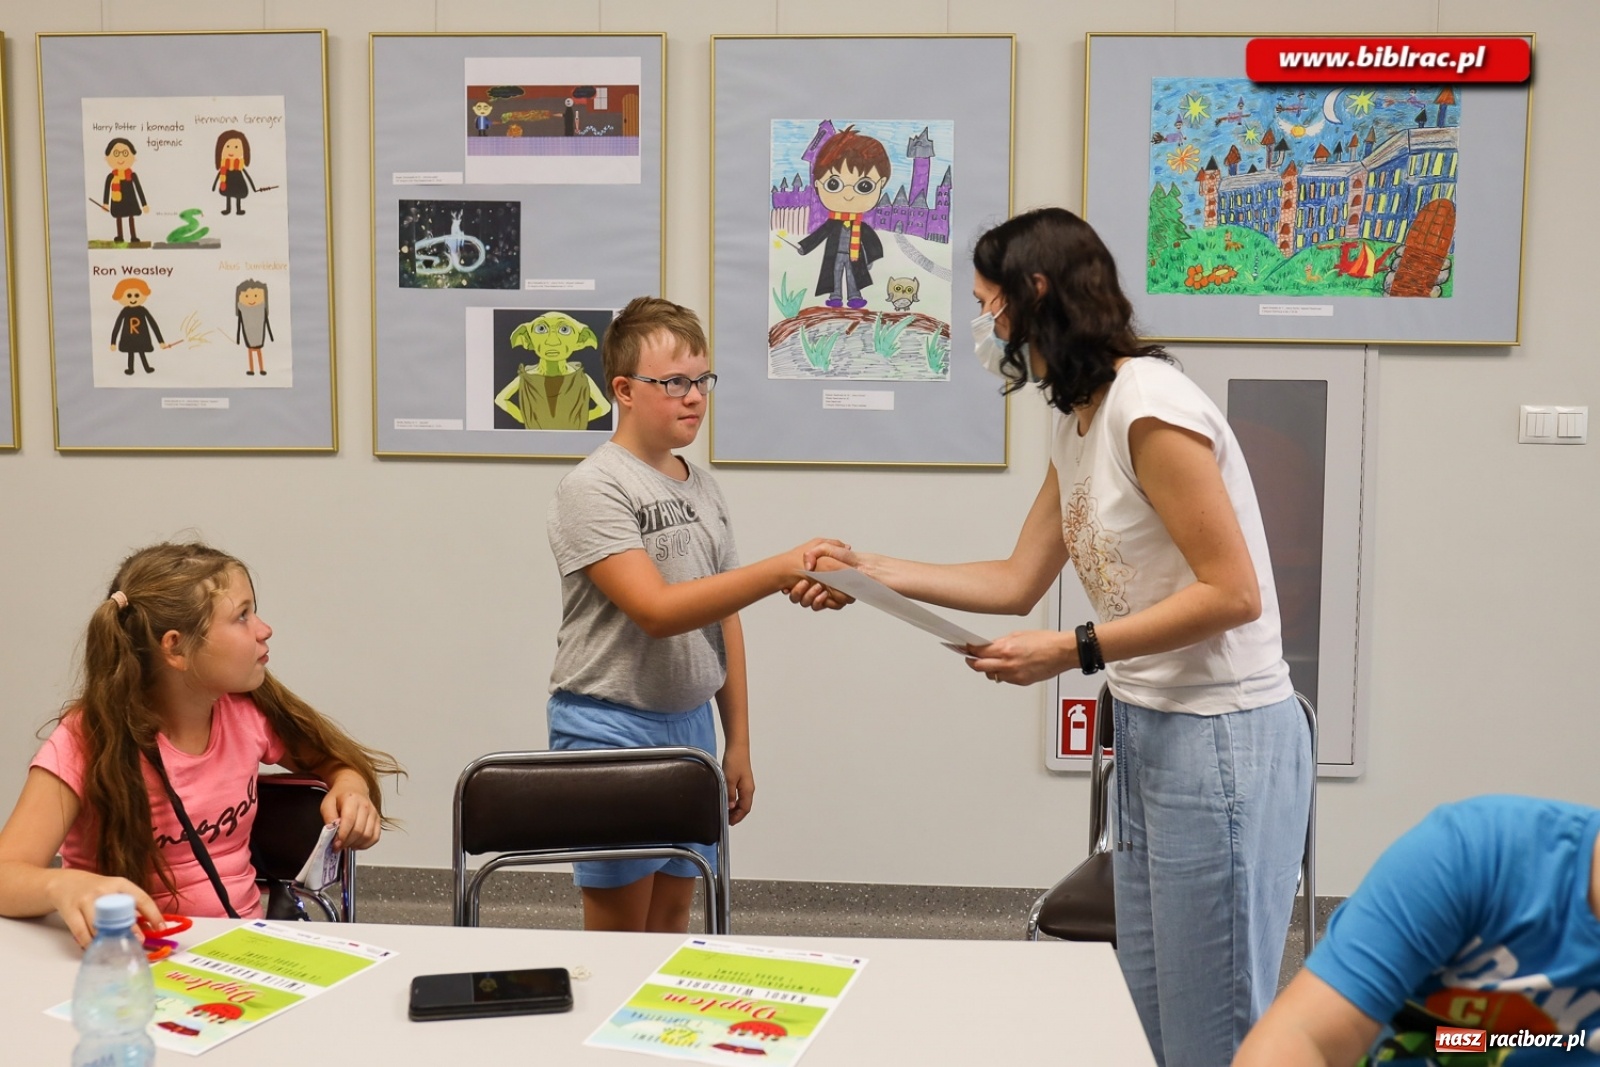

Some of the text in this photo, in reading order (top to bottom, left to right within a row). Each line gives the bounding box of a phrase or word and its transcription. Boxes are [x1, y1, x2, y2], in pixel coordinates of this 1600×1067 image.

[92, 122, 113, 134] Harry
[114, 122, 137, 132] Potter
[146, 121, 185, 132] komnata
[146, 136, 183, 152] tajemnic
[93, 265, 174, 278] Ron Weasley
[129, 316, 142, 336] R
